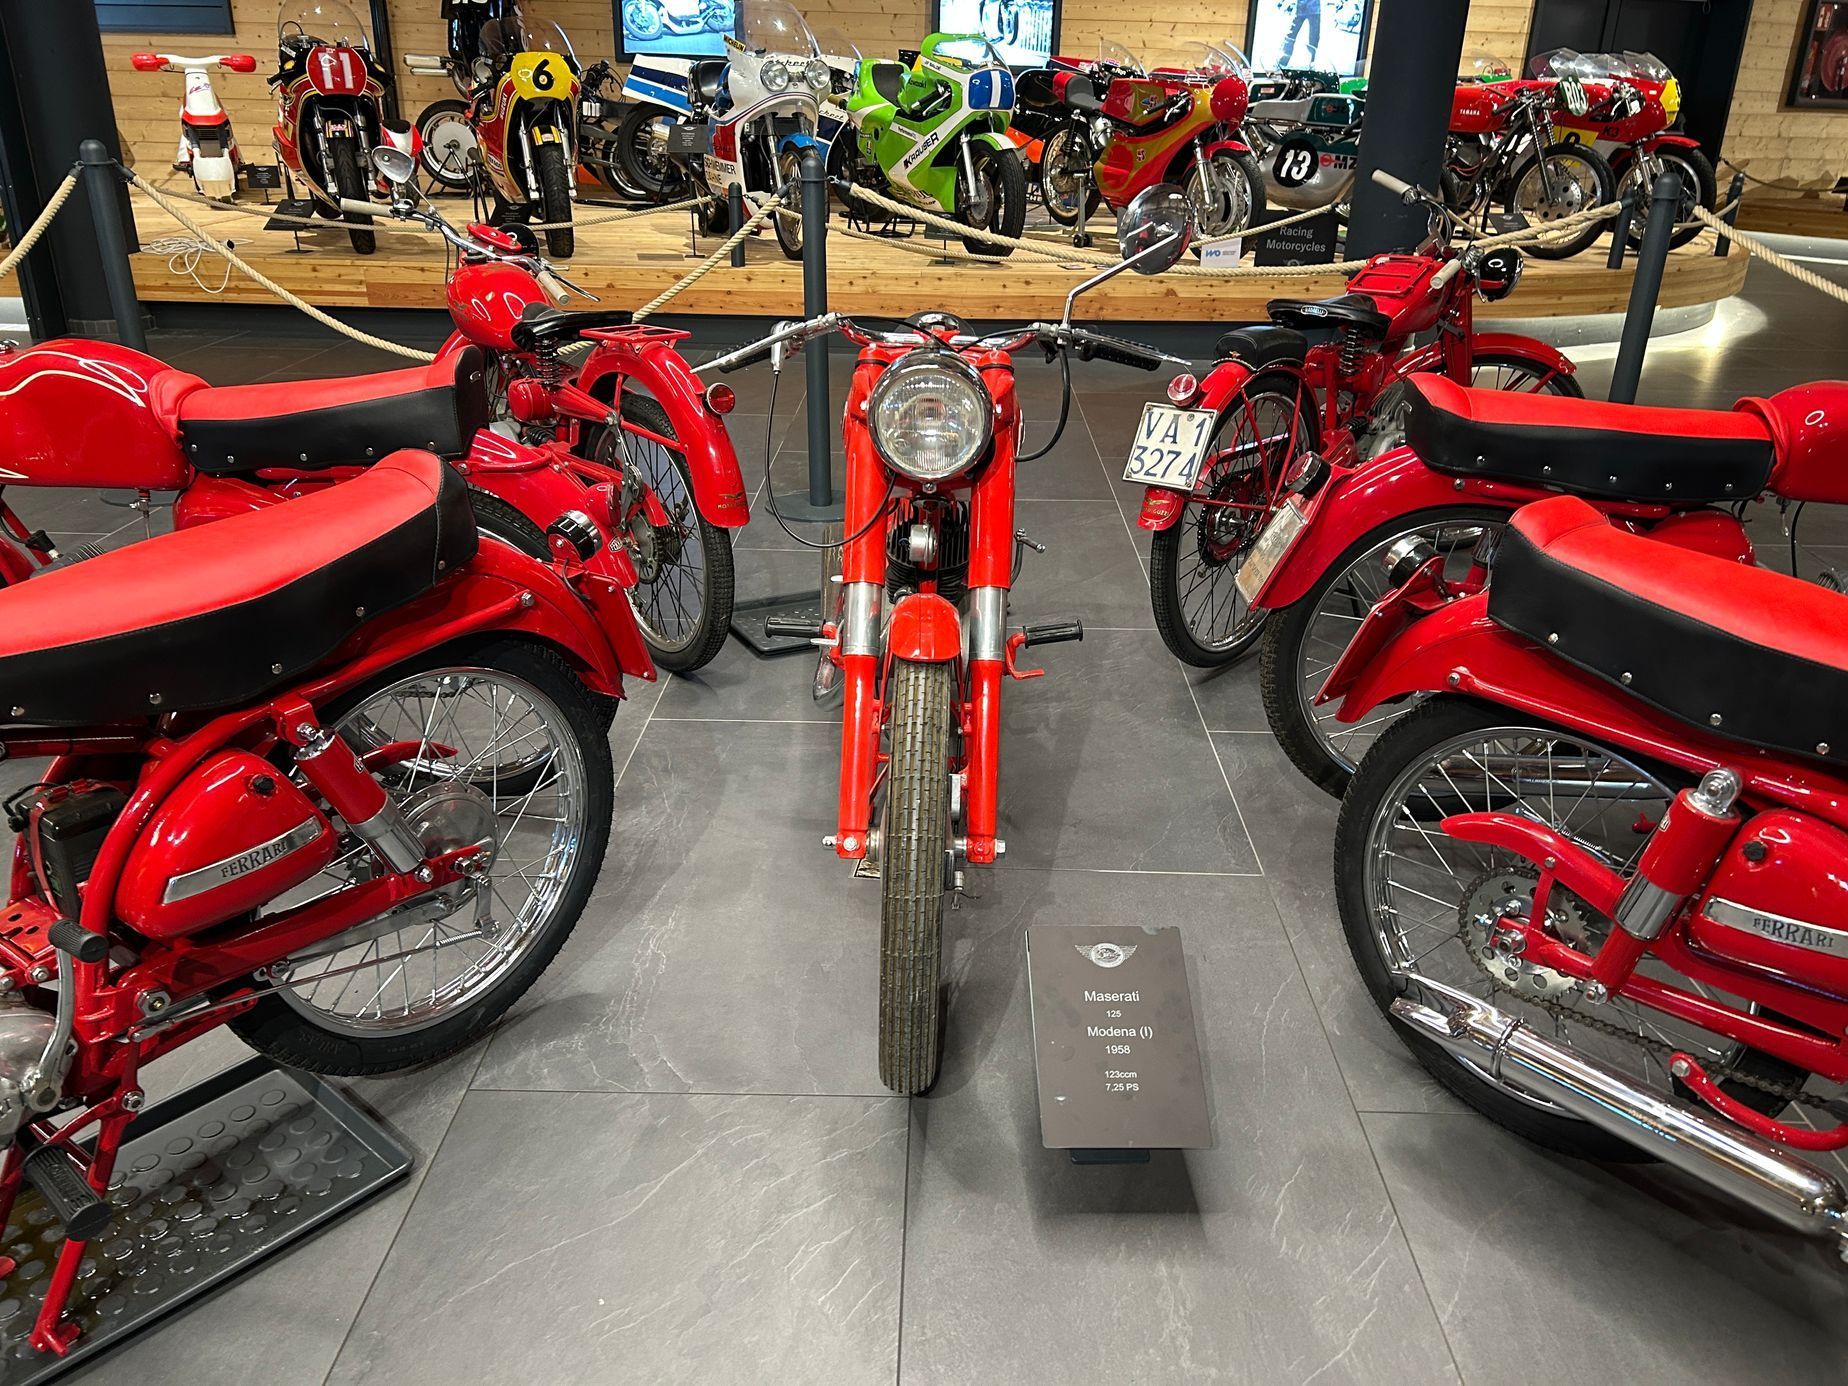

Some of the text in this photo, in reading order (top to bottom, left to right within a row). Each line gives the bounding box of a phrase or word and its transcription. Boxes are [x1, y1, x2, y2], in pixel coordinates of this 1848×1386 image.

[318, 52, 354, 89] 11
[532, 59, 554, 91] 6
[1459, 108, 1480, 117] YAMAHA
[903, 131, 940, 171] KRAUSER
[1280, 149, 1312, 181] 13
[1279, 225, 1314, 238] Racing
[1266, 239, 1326, 253] Motorcycles
[1130, 445, 1198, 482] 3274
[221, 841, 287, 877] FERRARI
[1753, 918, 1834, 948] FERRARI
[1084, 991, 1140, 1002] Maserati
[1106, 1010, 1122, 1018] 125
[1087, 1026, 1154, 1040] Modena (I)
[1105, 1045, 1131, 1055] 1958
[1104, 1070, 1138, 1079] 123ccm
[1105, 1083, 1140, 1093] 7,25 PS
